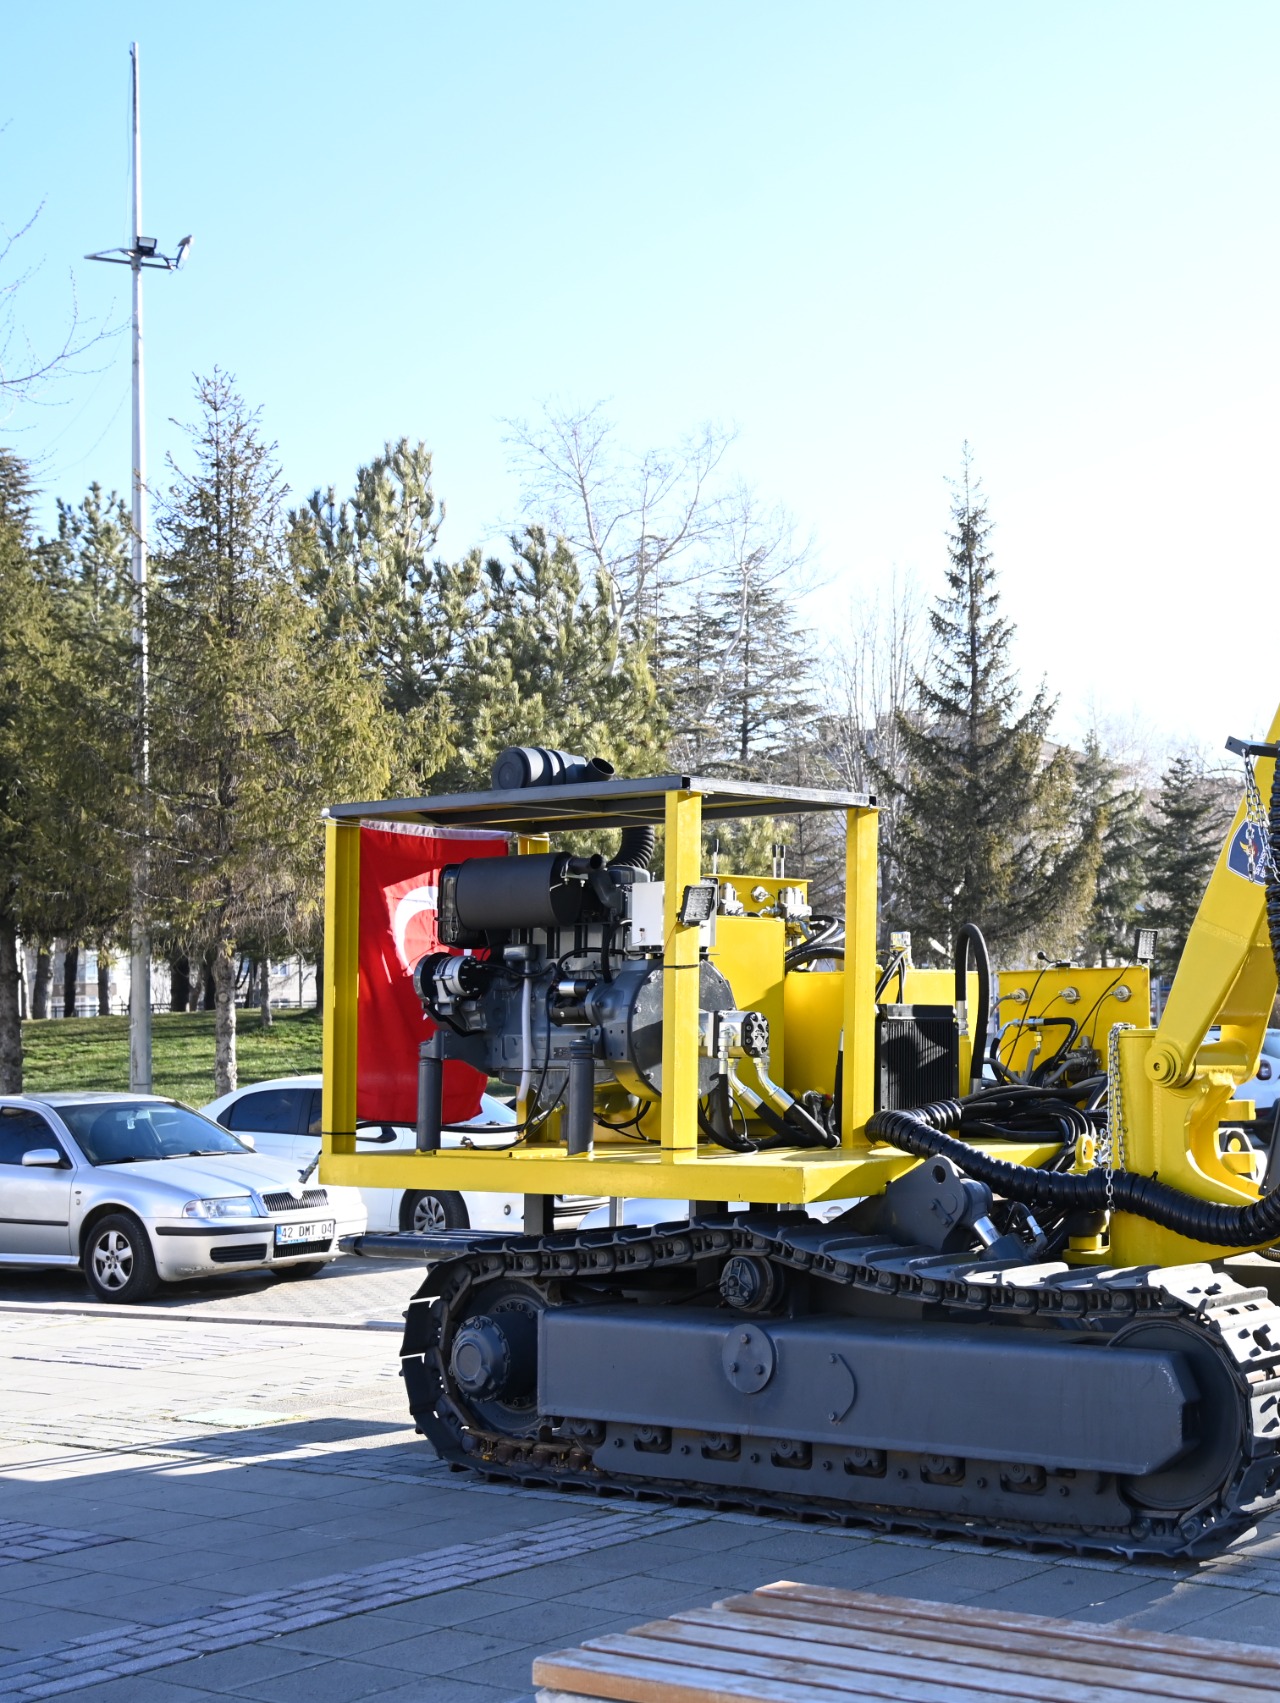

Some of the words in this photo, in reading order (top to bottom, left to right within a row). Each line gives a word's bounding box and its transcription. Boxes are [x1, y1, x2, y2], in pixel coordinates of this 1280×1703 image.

[281, 1226, 293, 1238] 42
[299, 1224, 316, 1237] DMT
[321, 1223, 332, 1234] 04
